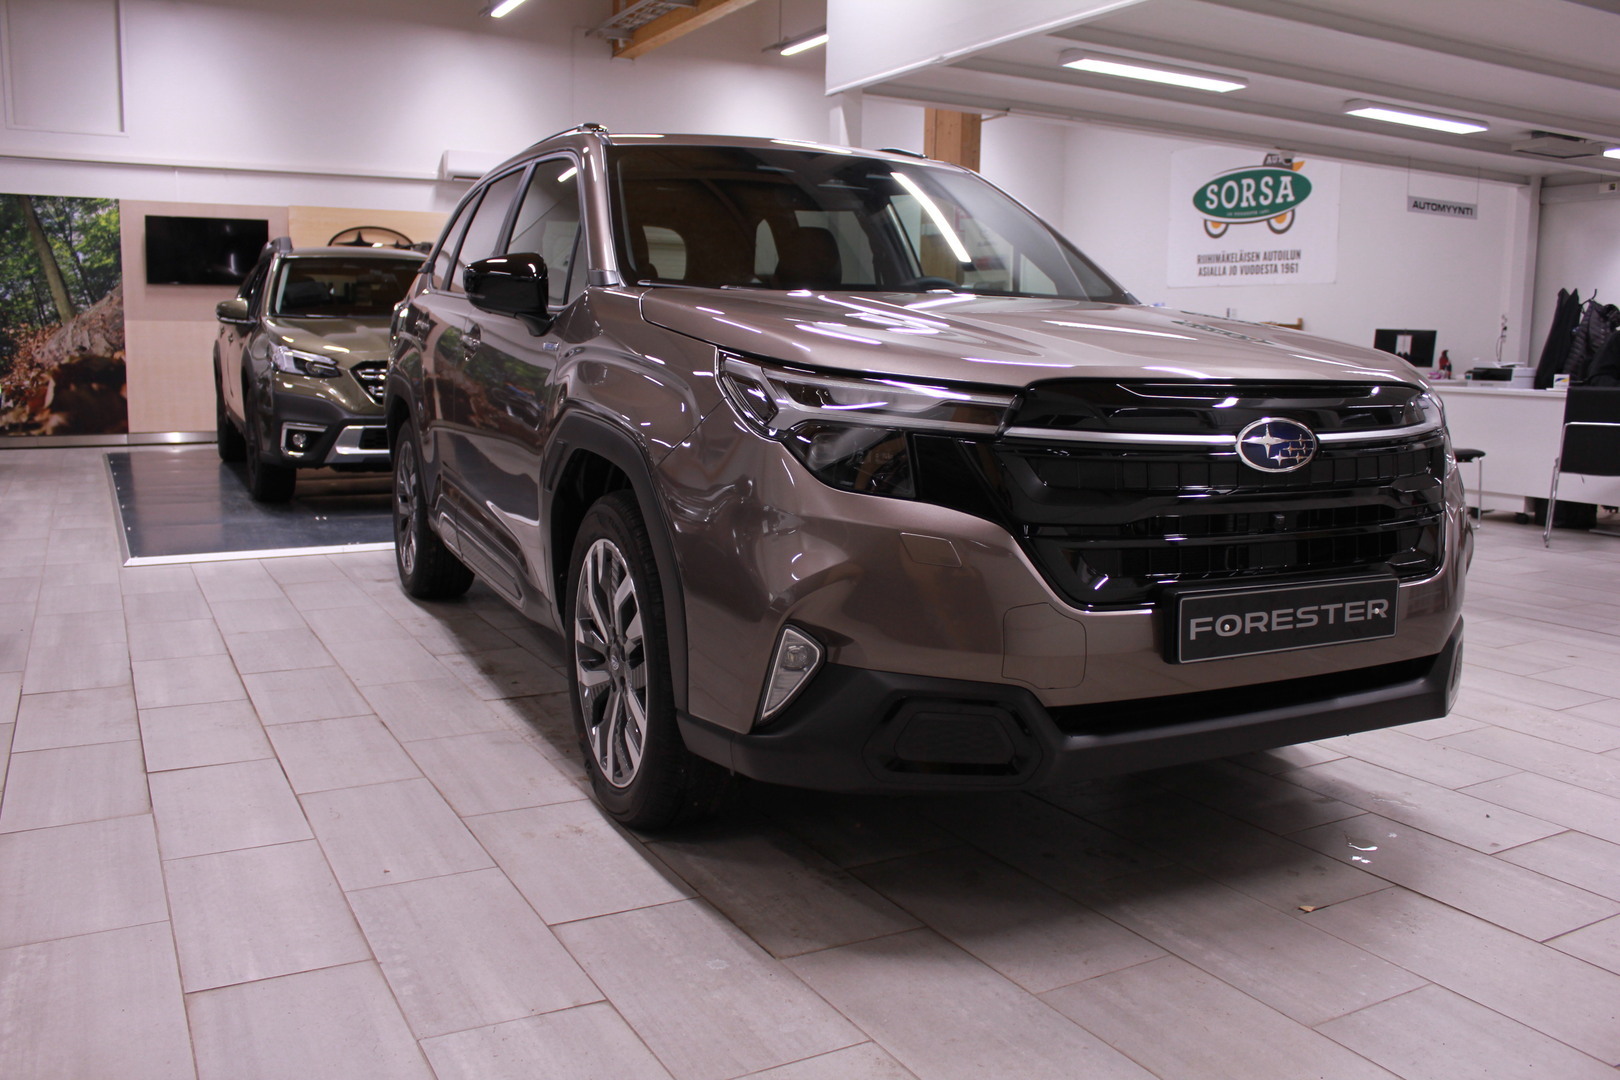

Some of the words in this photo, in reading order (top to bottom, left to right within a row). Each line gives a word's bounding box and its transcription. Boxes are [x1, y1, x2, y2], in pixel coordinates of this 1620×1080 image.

[1205, 175, 1295, 209] SORSA
[1412, 201, 1473, 216] AUTOMYYNTI
[1262, 249, 1301, 261] AUTOILUN
[1198, 265, 1226, 276] ASIALLA
[1229, 265, 1237, 276] JO
[1240, 263, 1278, 275] VUODESTA
[1281, 262, 1299, 274] 1961
[1189, 599, 1389, 641] FORESTER
